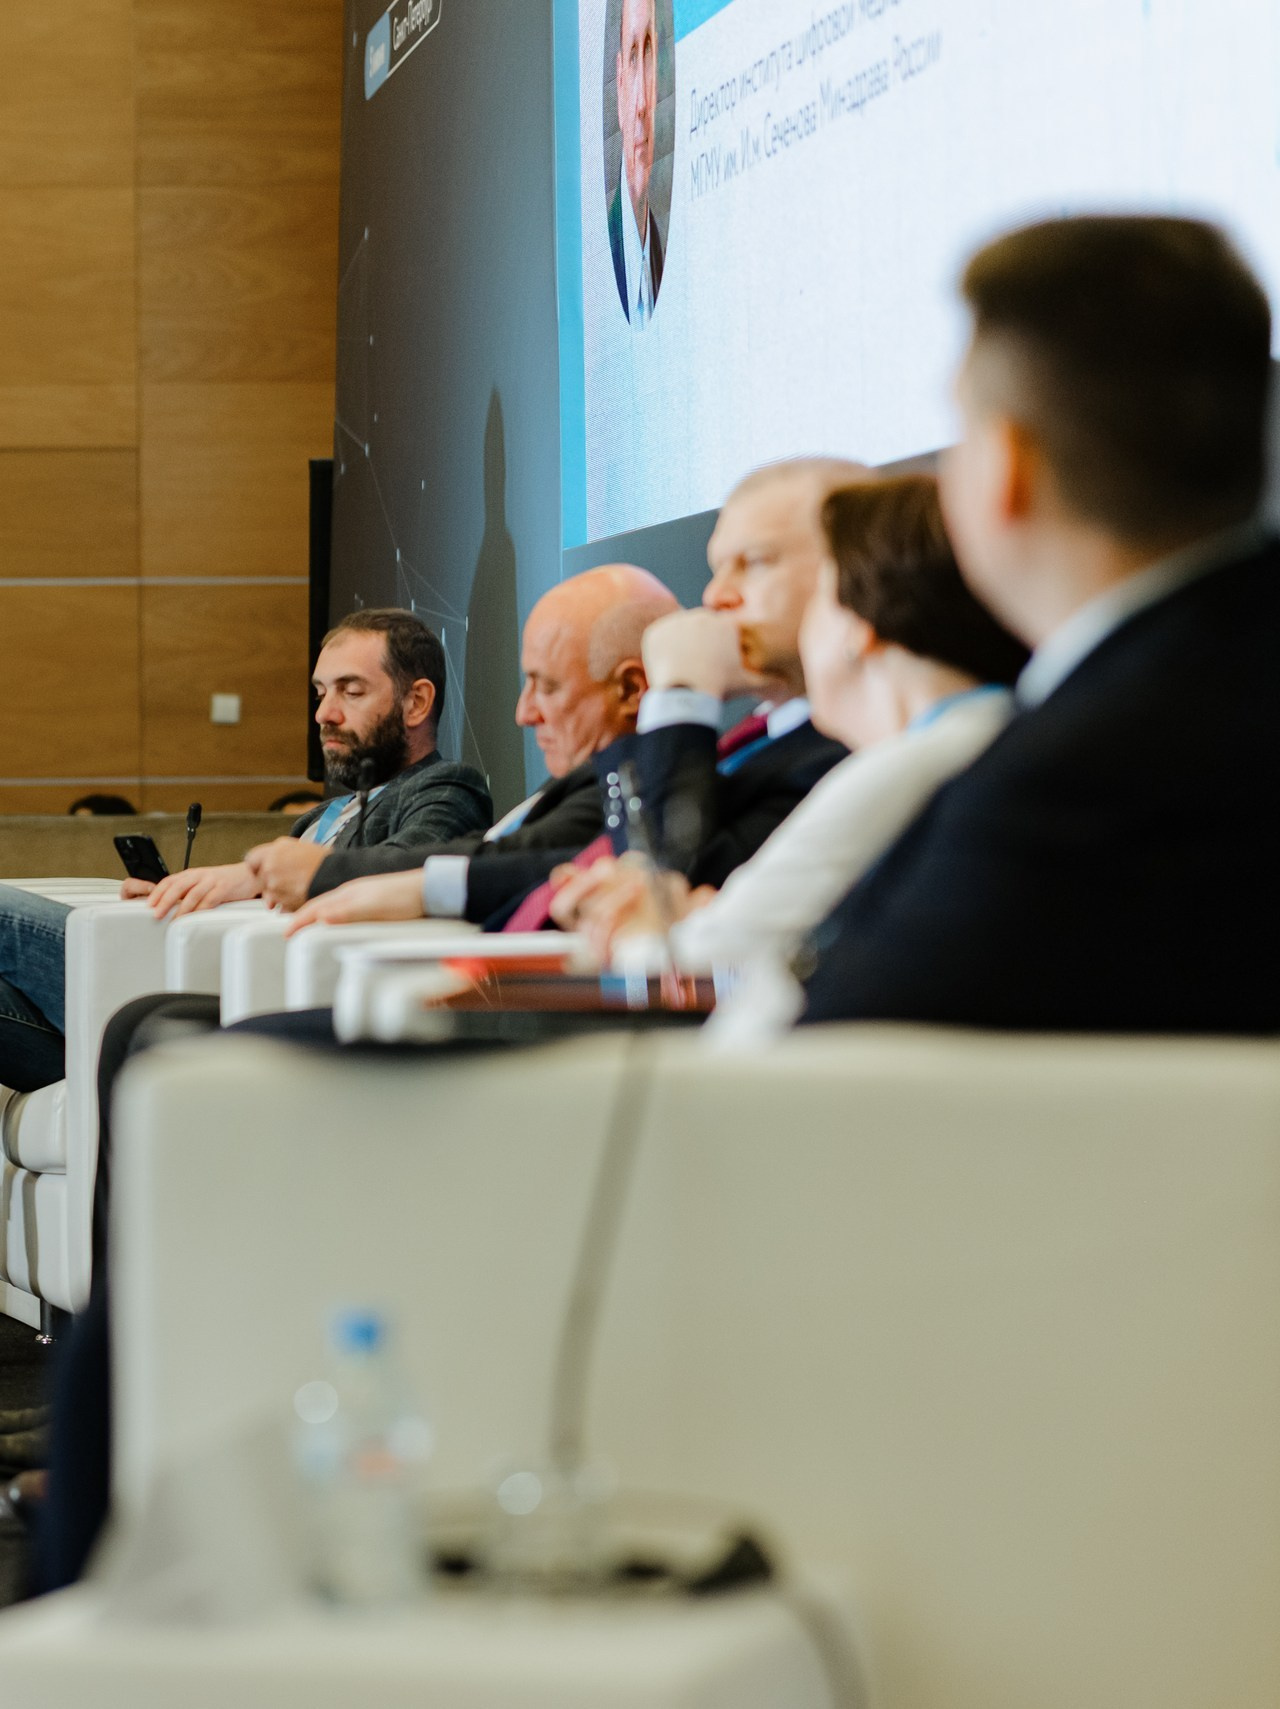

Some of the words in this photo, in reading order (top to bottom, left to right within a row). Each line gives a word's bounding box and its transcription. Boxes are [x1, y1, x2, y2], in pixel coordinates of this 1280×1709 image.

[688, 77, 736, 141] Директор
[739, 40, 791, 99] института
[690, 143, 721, 202] МГМУ
[763, 101, 816, 158] Сеченова
